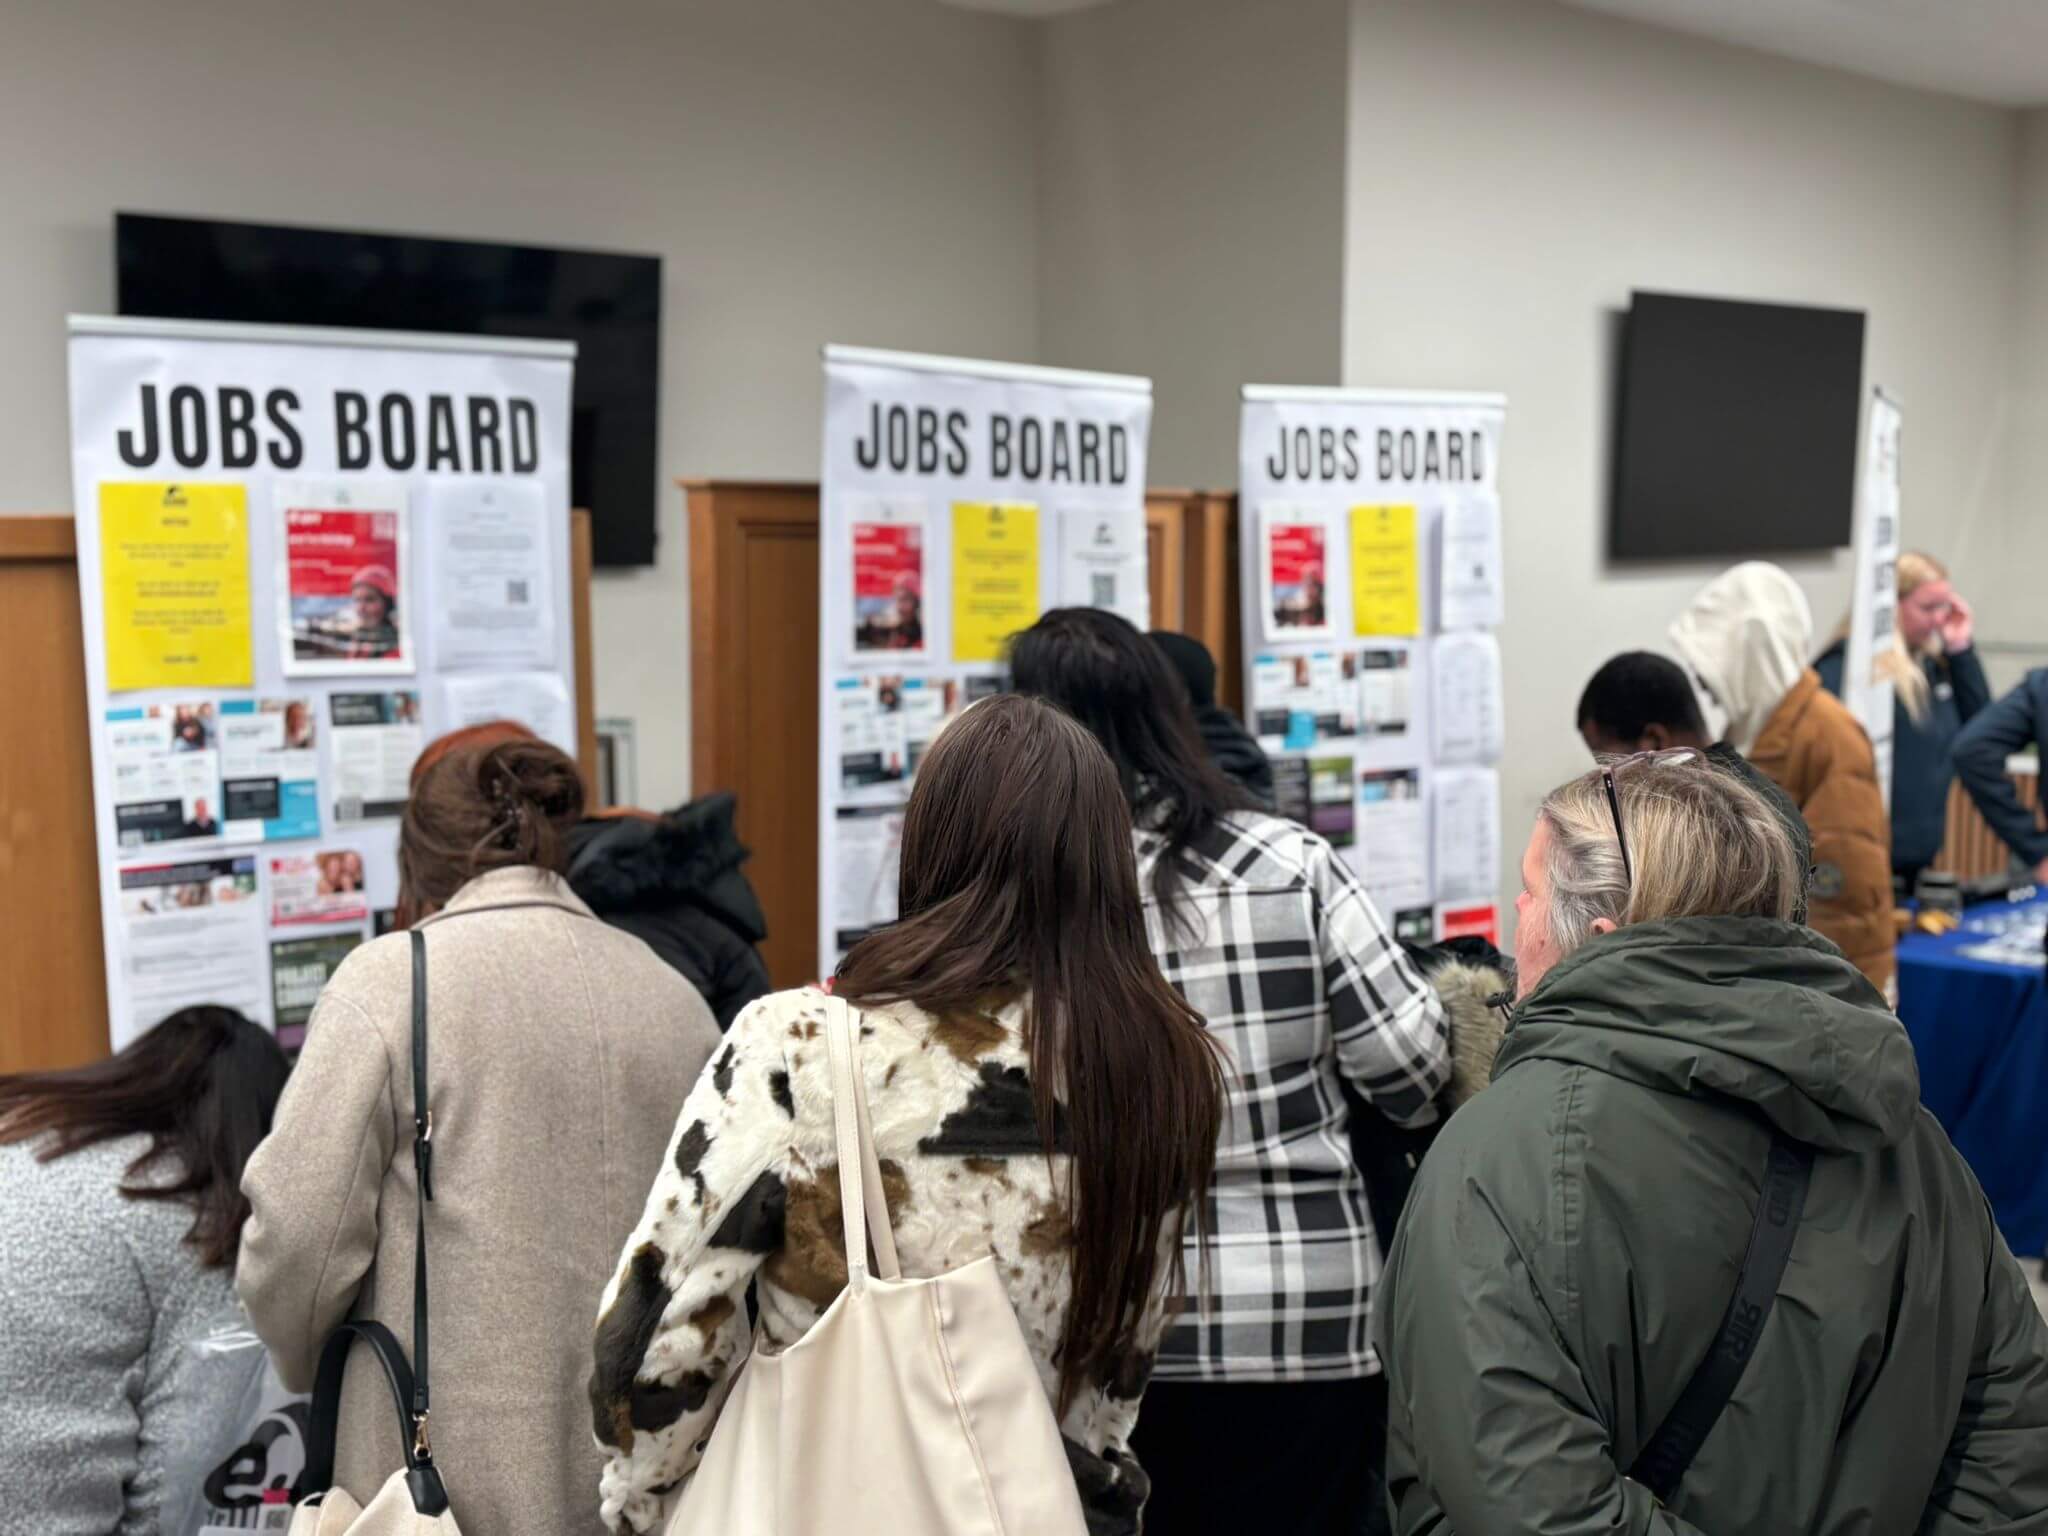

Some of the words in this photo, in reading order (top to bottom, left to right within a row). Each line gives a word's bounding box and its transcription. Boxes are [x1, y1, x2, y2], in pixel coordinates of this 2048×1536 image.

[117, 384, 304, 470] JOBS
[334, 391, 539, 474] BOARD
[855, 402, 970, 478] JOBS
[989, 413, 1128, 486] BOARD
[1266, 426, 1360, 482] JOBS
[1376, 428, 1484, 482] BOARD
